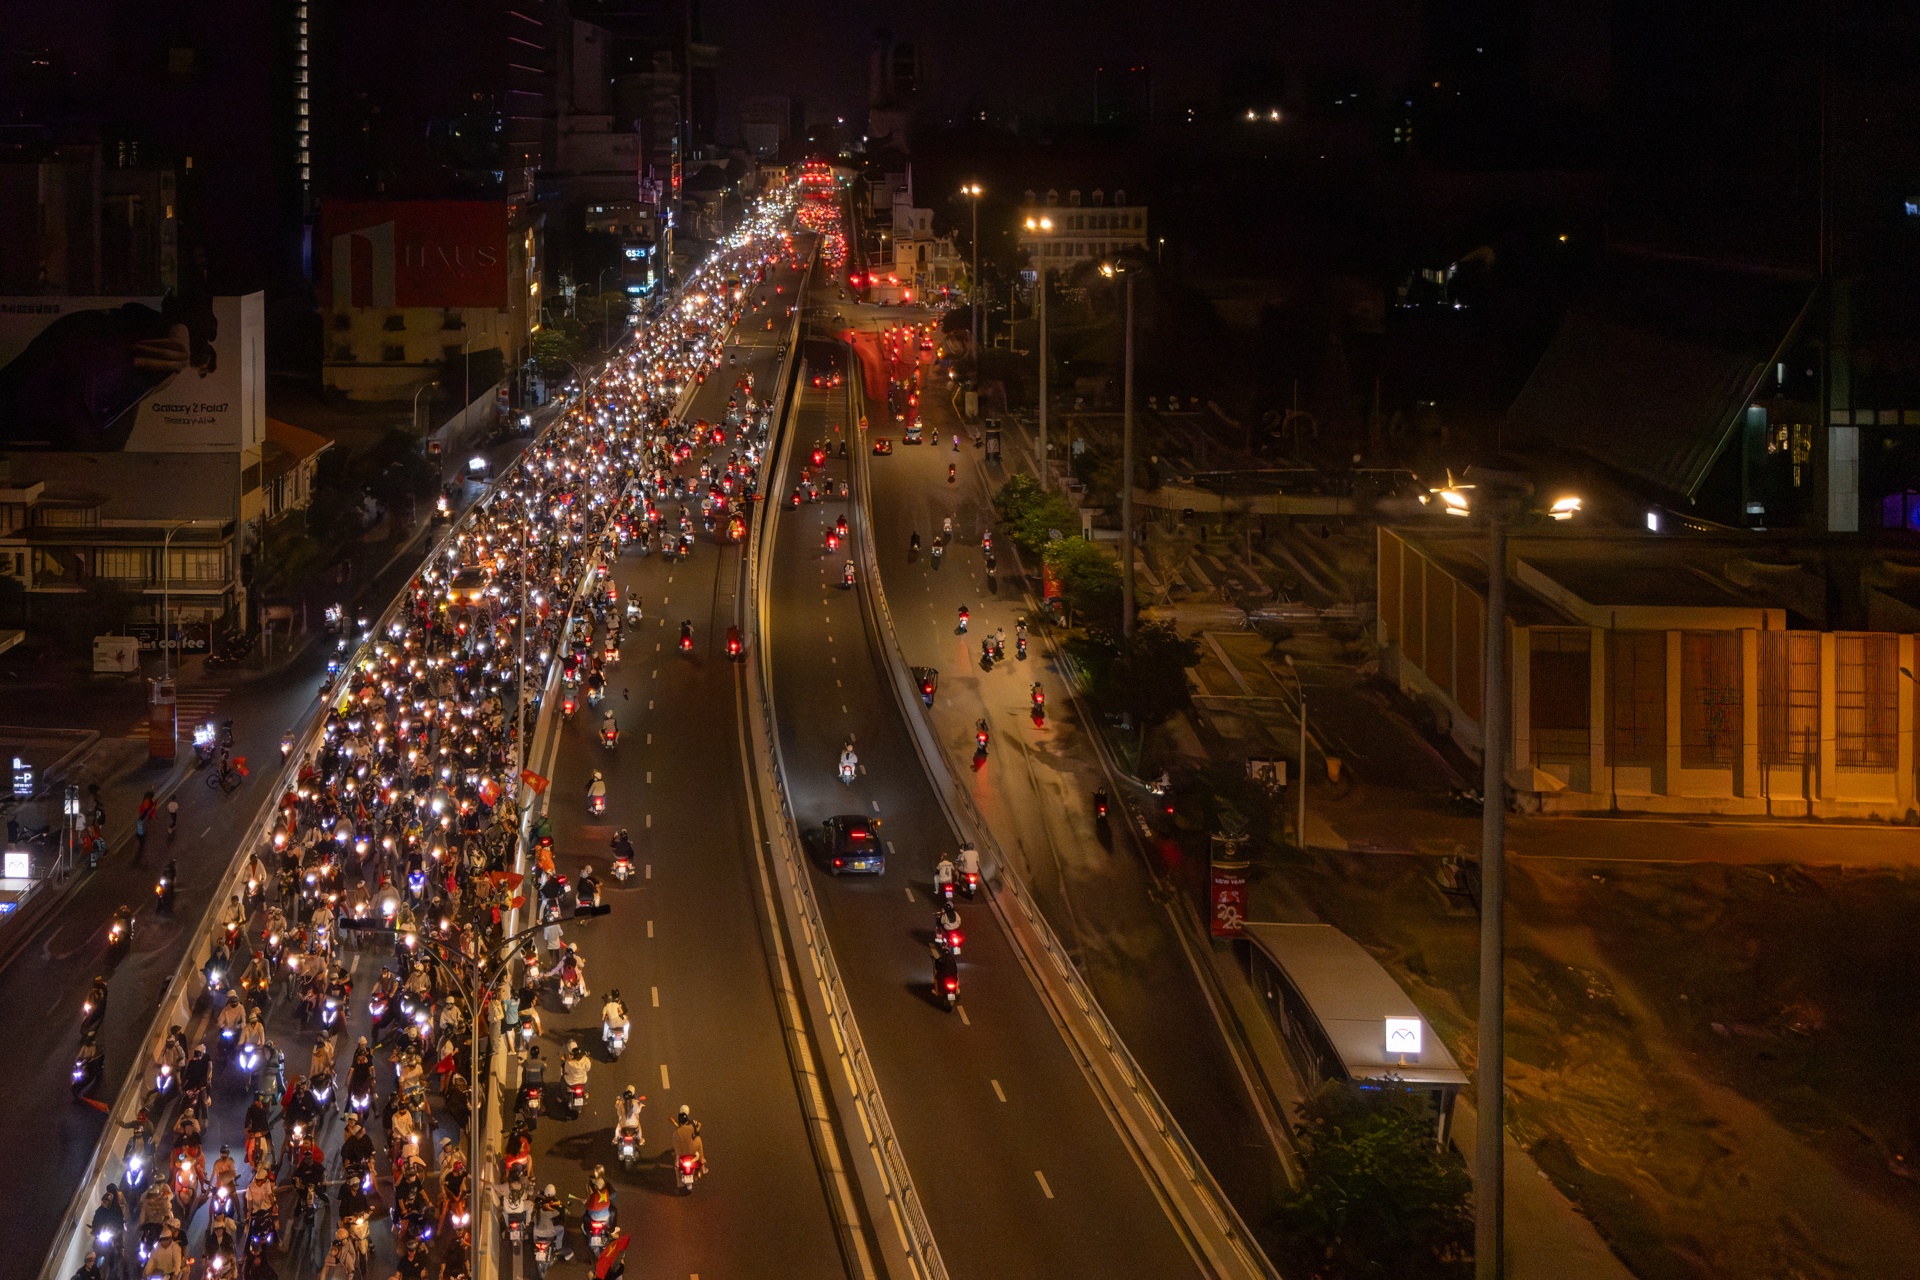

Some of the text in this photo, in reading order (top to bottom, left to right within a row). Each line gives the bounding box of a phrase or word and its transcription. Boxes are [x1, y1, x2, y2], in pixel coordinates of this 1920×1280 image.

[626, 249, 646, 257] GS25
[152, 403, 192, 415] Galaxy
[200, 403, 229, 413] Fold7
[23, 772, 32, 783] P
